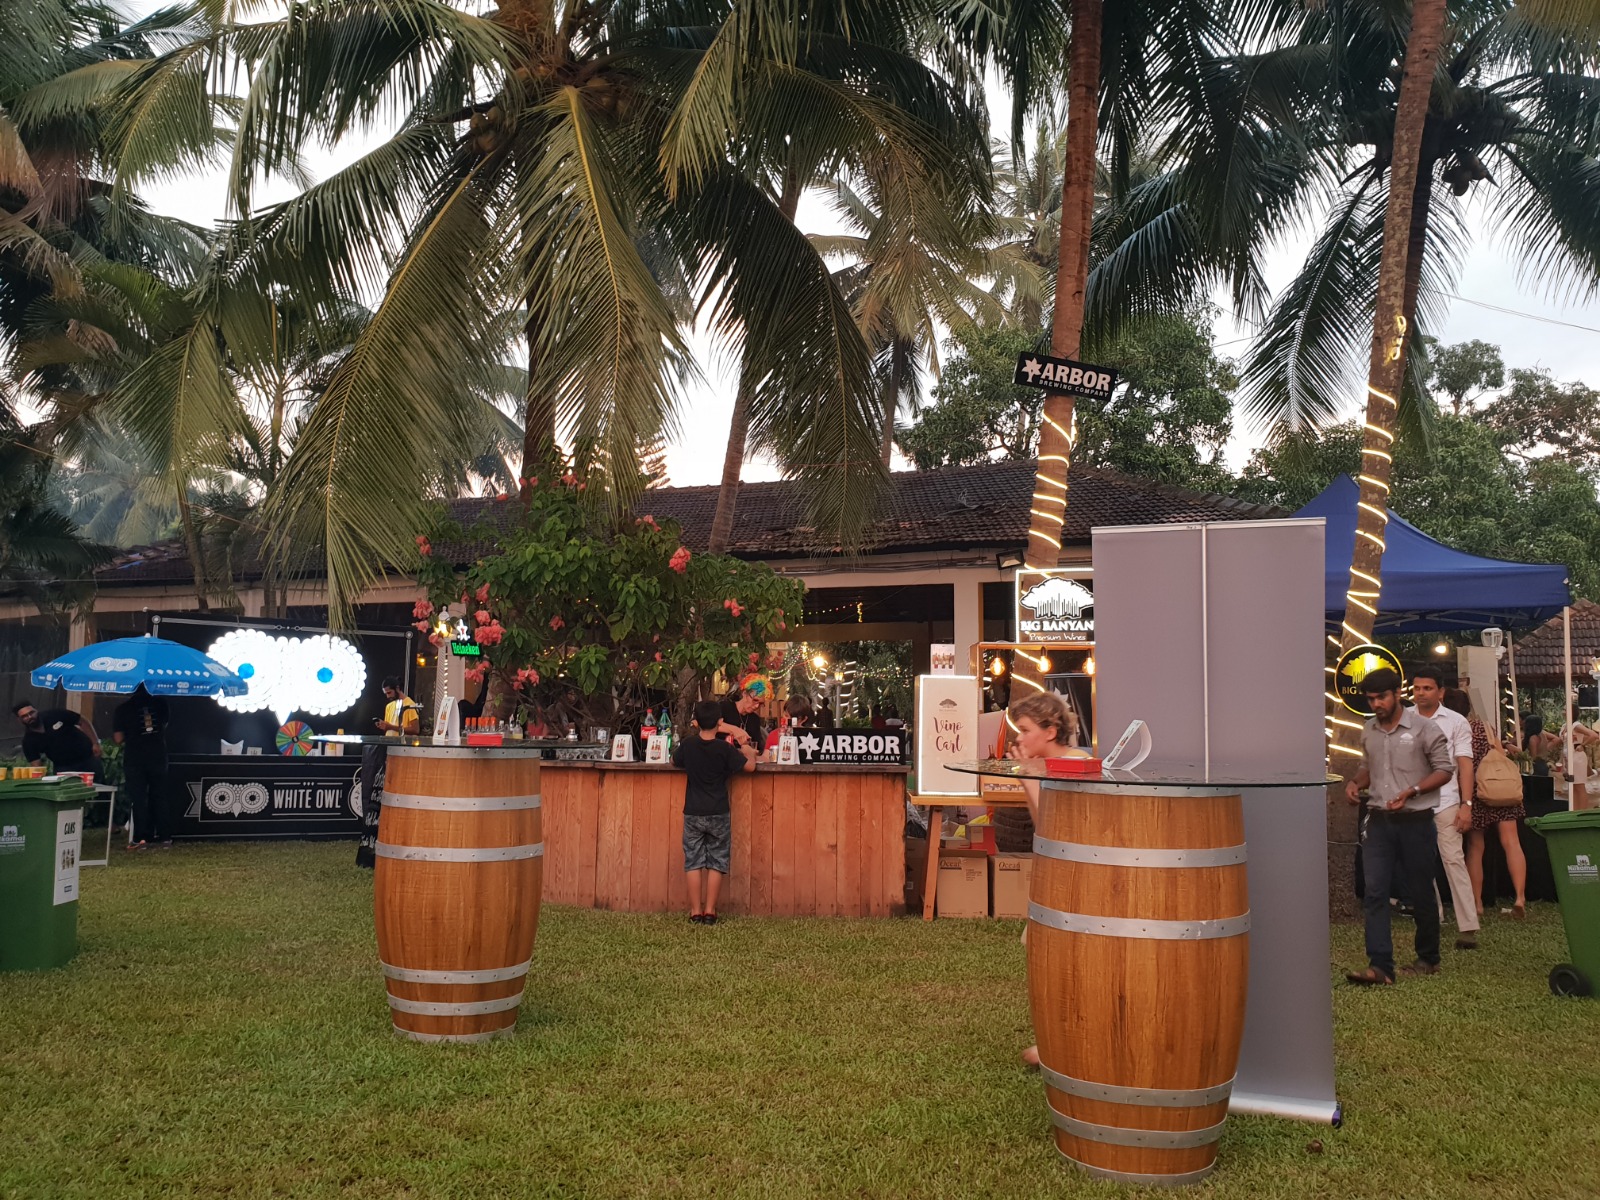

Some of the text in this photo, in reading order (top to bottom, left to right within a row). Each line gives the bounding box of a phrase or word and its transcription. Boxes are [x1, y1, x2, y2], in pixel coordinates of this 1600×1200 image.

[1040, 363, 1111, 391] ARBOR
[1039, 380, 1109, 398] BREWING COMPANY
[1042, 620, 1094, 631] BANYAN
[1030, 632, 1086, 641] Premium Wines
[1342, 686, 1357, 695] BIG
[934, 717, 964, 734] Vino
[820, 735, 900, 754] ARBOR
[936, 734, 962, 753] Cart
[273, 789, 312, 808] WHITE
[315, 789, 341, 808] OWL
